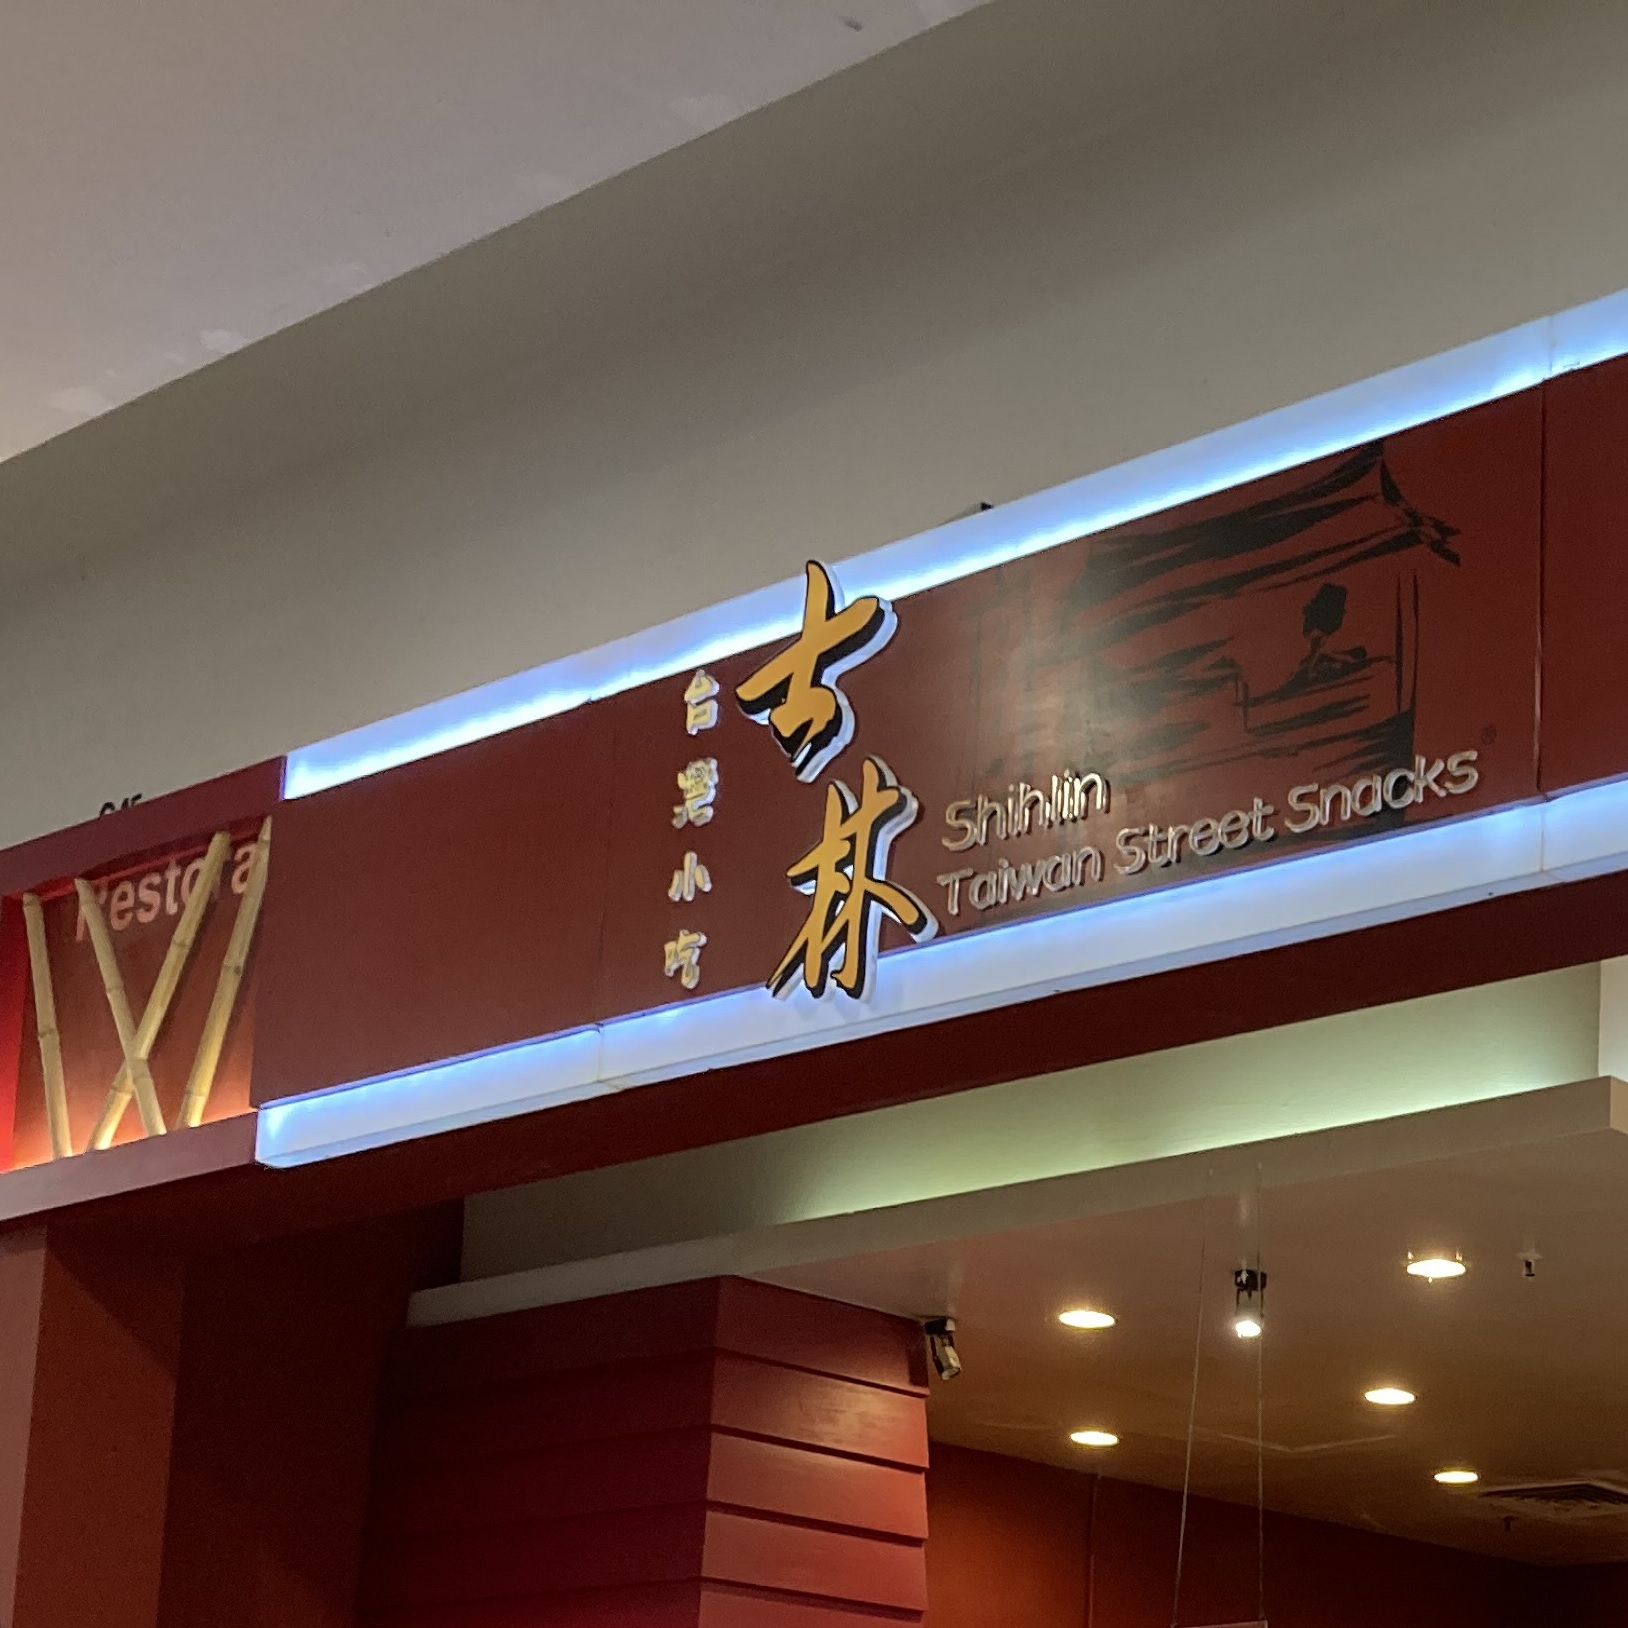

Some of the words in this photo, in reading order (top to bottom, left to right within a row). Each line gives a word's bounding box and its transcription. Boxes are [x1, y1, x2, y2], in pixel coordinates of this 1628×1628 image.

[936, 843, 1102, 916] Taiwan
[1114, 797, 1275, 875] Street
[1287, 749, 1480, 834] Snacks
[941, 769, 1110, 852] Shihlin
